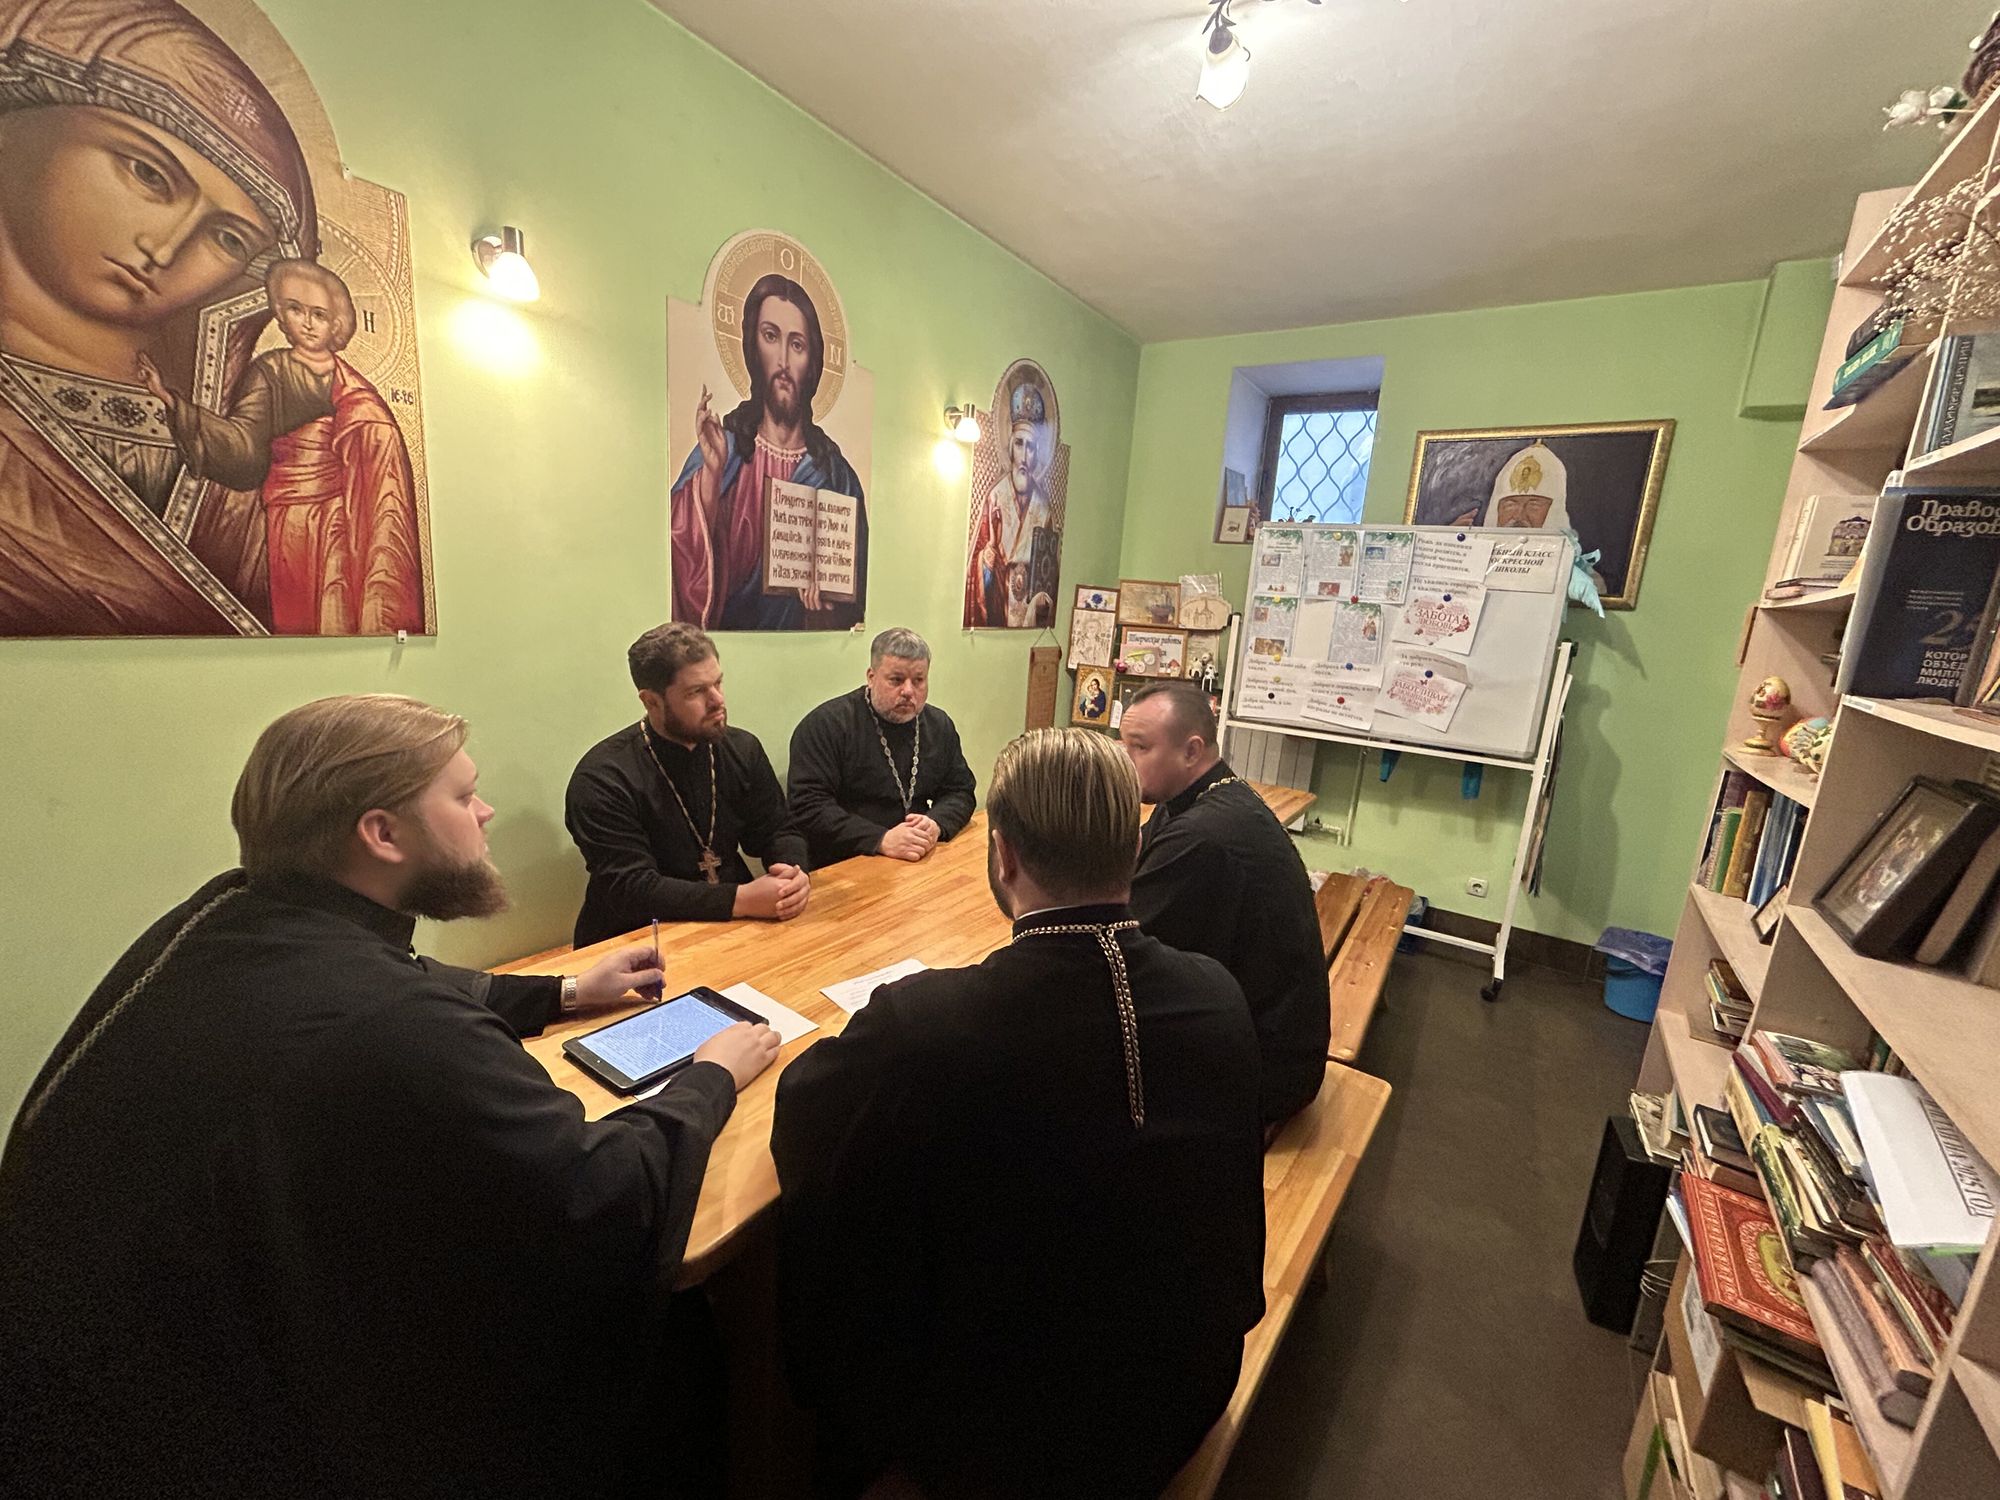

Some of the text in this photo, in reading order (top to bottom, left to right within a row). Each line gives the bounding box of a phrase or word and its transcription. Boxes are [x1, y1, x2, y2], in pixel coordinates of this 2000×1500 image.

[1524, 550, 1555, 558] КЛАСС
[1414, 608, 1460, 625] ЗАБОТА
[1925, 650, 1968, 660] КОТОР
